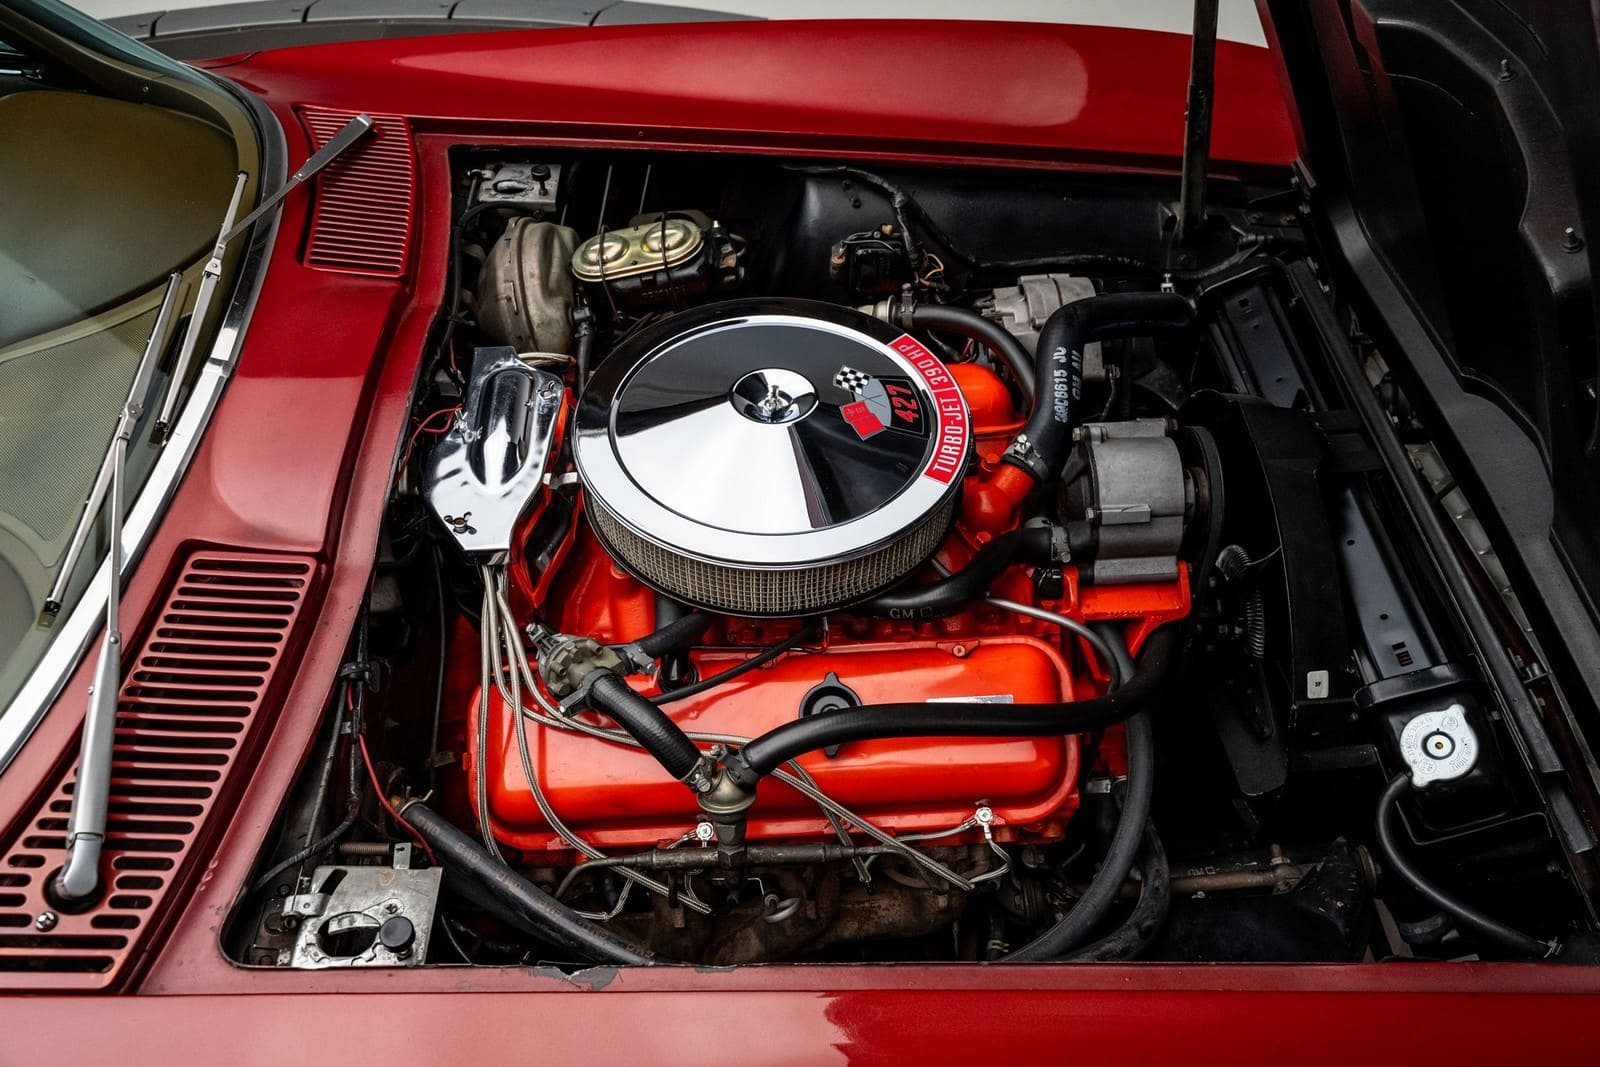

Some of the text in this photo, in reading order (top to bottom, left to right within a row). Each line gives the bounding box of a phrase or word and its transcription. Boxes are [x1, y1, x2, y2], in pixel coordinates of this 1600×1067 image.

[886, 384, 919, 423] 427
[898, 343, 964, 473] TURBO-JET 390 HP
[889, 607, 915, 620] GM
